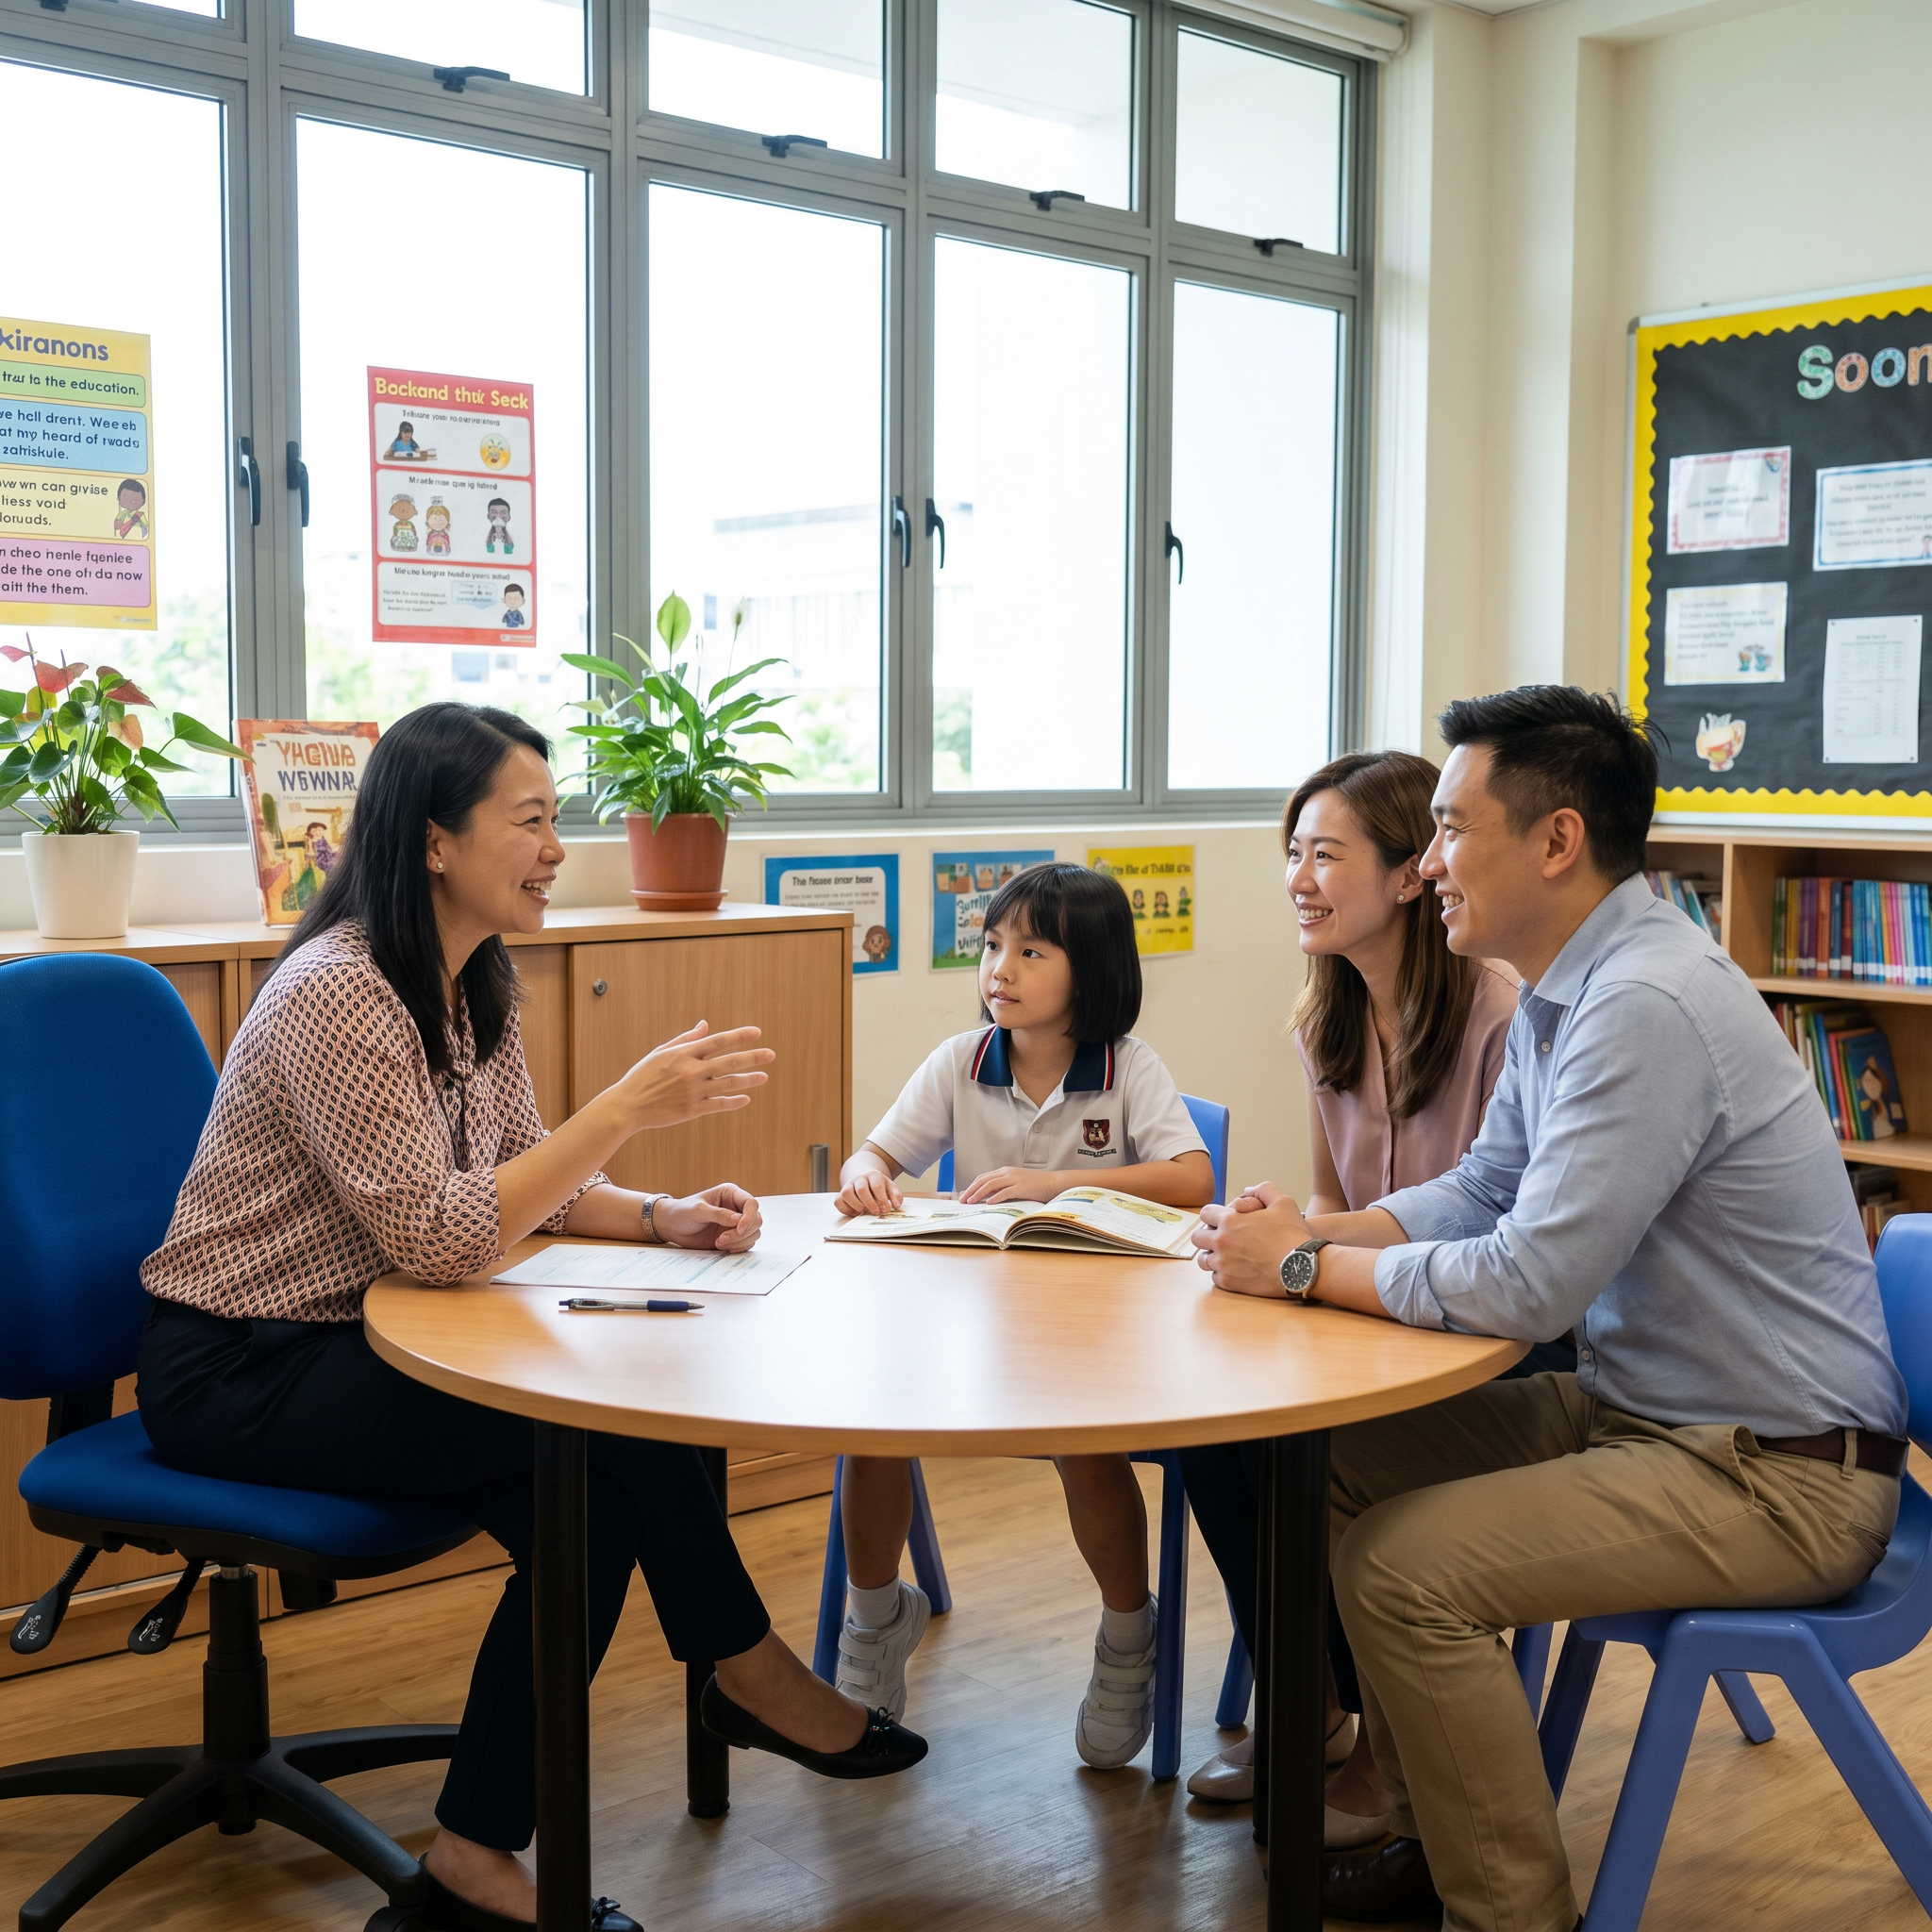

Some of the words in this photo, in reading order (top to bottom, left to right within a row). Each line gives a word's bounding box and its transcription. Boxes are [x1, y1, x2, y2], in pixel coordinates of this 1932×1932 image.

[45, 375, 66, 388] the
[71, 379, 139, 395] education.
[491, 390, 529, 409] Seck
[42, 429, 81, 443] heard
[86, 434, 98, 445] of
[42, 482, 66, 492] can
[10, 546, 42, 558] cheo
[1, 563, 17, 575] de
[22, 564, 42, 575] the
[47, 568, 72, 577] one
[116, 572, 142, 580] now
[26, 582, 47, 593] the
[51, 583, 88, 595] them.
